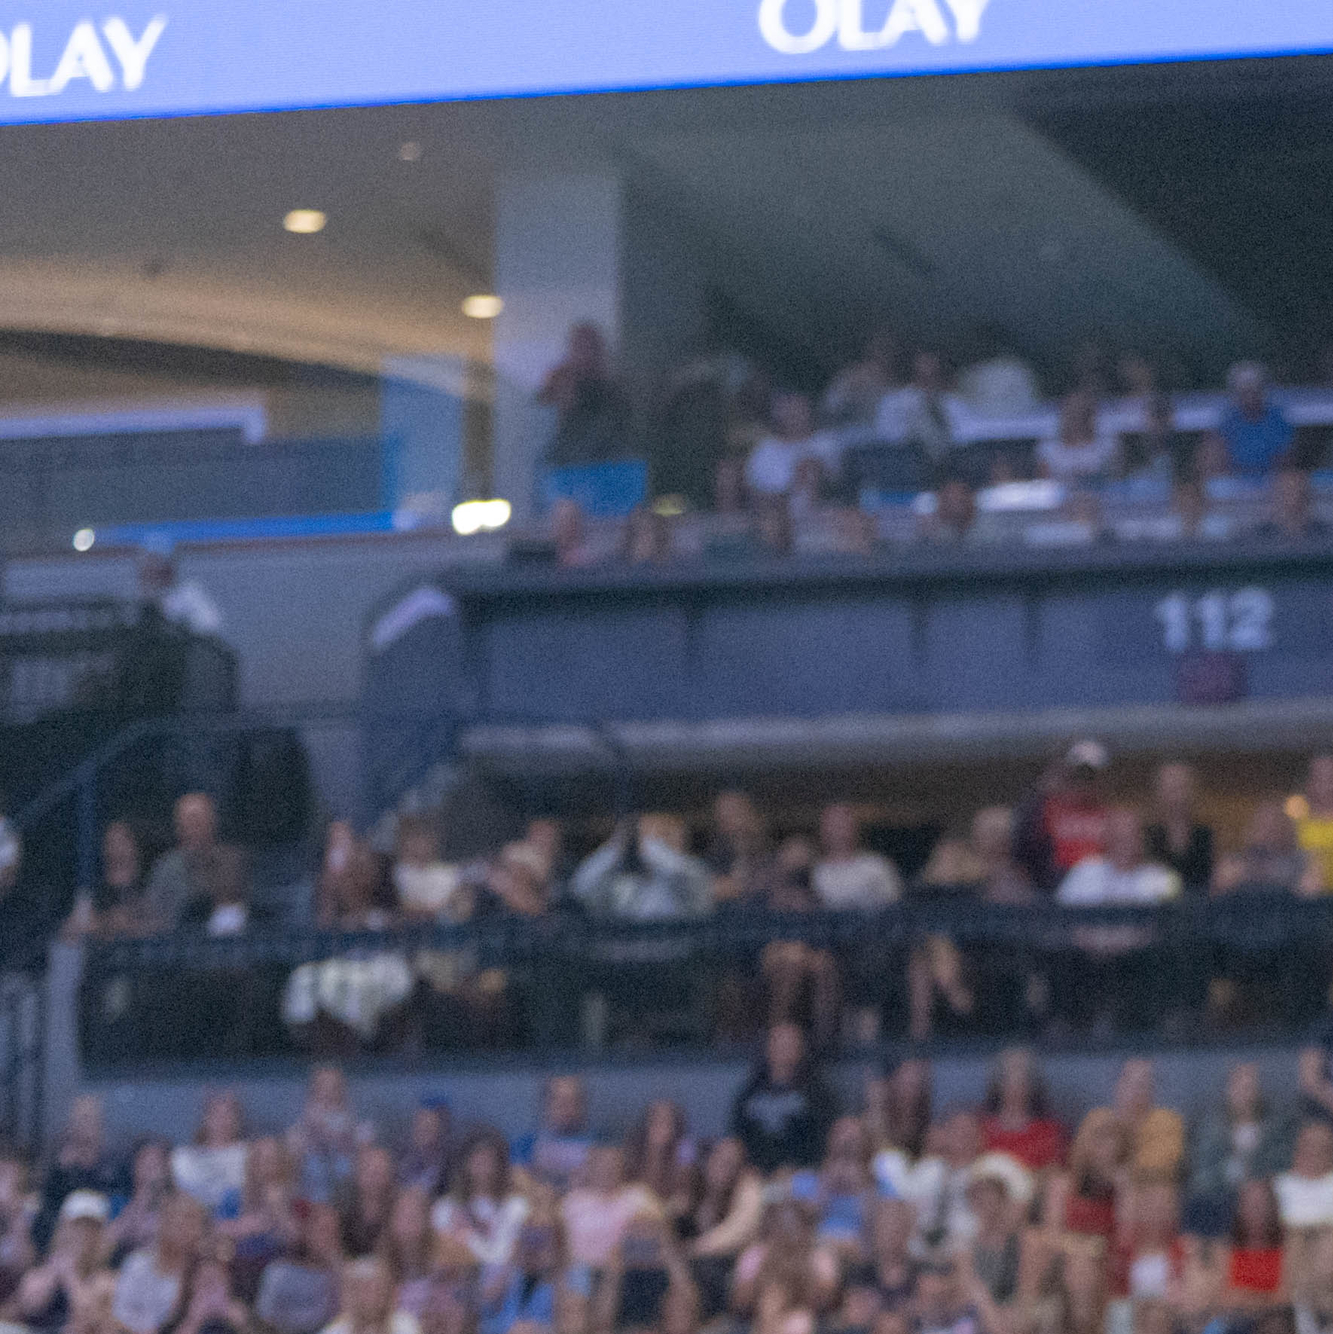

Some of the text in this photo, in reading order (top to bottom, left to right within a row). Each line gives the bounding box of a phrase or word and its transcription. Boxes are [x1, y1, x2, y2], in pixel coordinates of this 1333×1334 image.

[0, 14, 167, 97] LAY
[759, 0, 992, 54] OLAY
[1154, 587, 1272, 650] 112
